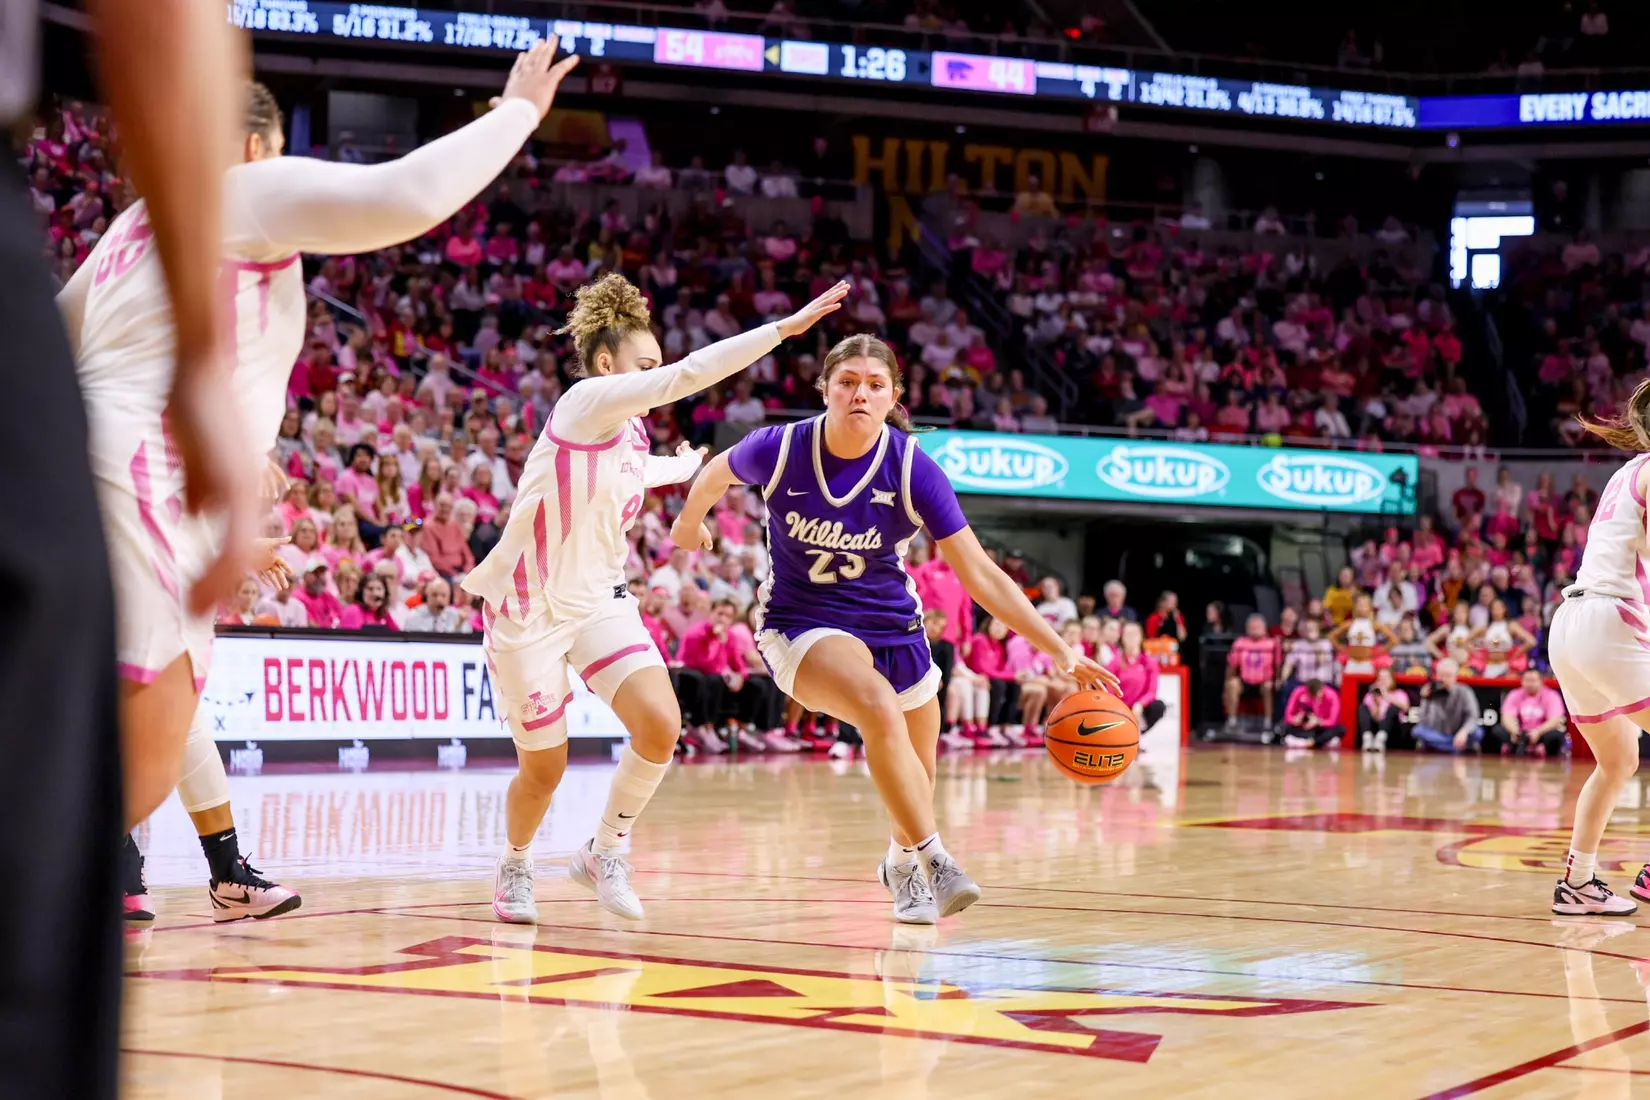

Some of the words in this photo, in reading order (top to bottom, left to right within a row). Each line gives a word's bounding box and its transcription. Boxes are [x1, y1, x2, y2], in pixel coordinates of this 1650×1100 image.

[664, 30, 705, 64] 54
[841, 44, 907, 82] 1:26
[988, 58, 1025, 91] 44
[1519, 93, 1588, 122] EVERY
[852, 135, 1110, 207] HILTON
[943, 437, 1055, 484] Sukup
[1109, 445, 1218, 493] Sukup
[1269, 454, 1373, 497] Sukup
[785, 511, 883, 550] Wildcats
[805, 549, 867, 584] 23
[263, 657, 449, 722] BERKWOOD
[462, 662, 497, 721] FA
[1074, 751, 1125, 768] ELITE
